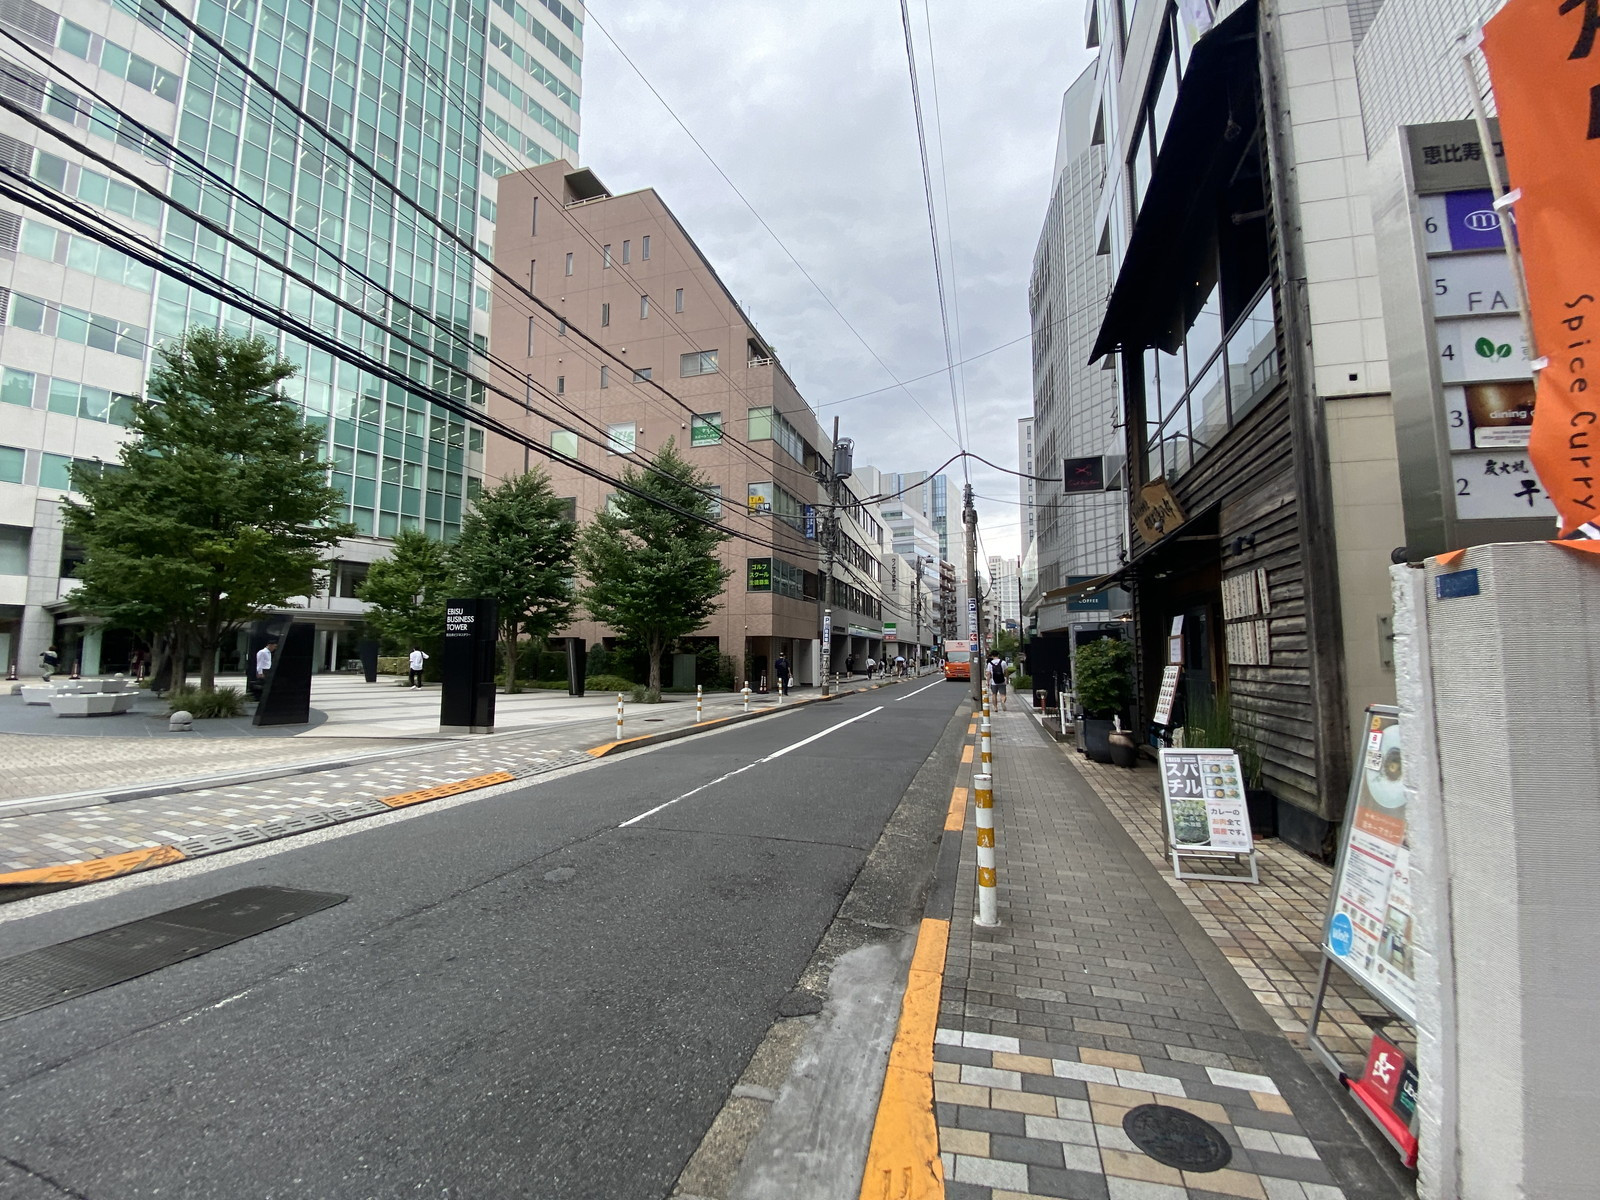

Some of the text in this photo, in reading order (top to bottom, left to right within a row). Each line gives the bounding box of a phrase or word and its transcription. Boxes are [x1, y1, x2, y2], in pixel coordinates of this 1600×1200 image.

[1425, 216, 1438, 234] 6
[1434, 278, 1448, 296] 5
[1441, 344, 1455, 361] 4
[1561, 293, 1597, 511] Spice Curry
[1450, 410, 1464, 428] 3
[1489, 409, 1528, 420] dining
[1456, 478, 1471, 496] 2
[447, 607, 464, 616] EBISU
[969, 603, 976, 611] P
[446, 615, 475, 623] BUSINESS
[446, 623, 468, 631] TOWER
[1166, 763, 1199, 777] スパ
[1168, 779, 1202, 794] チル
[1210, 807, 1240, 816] カレーの
